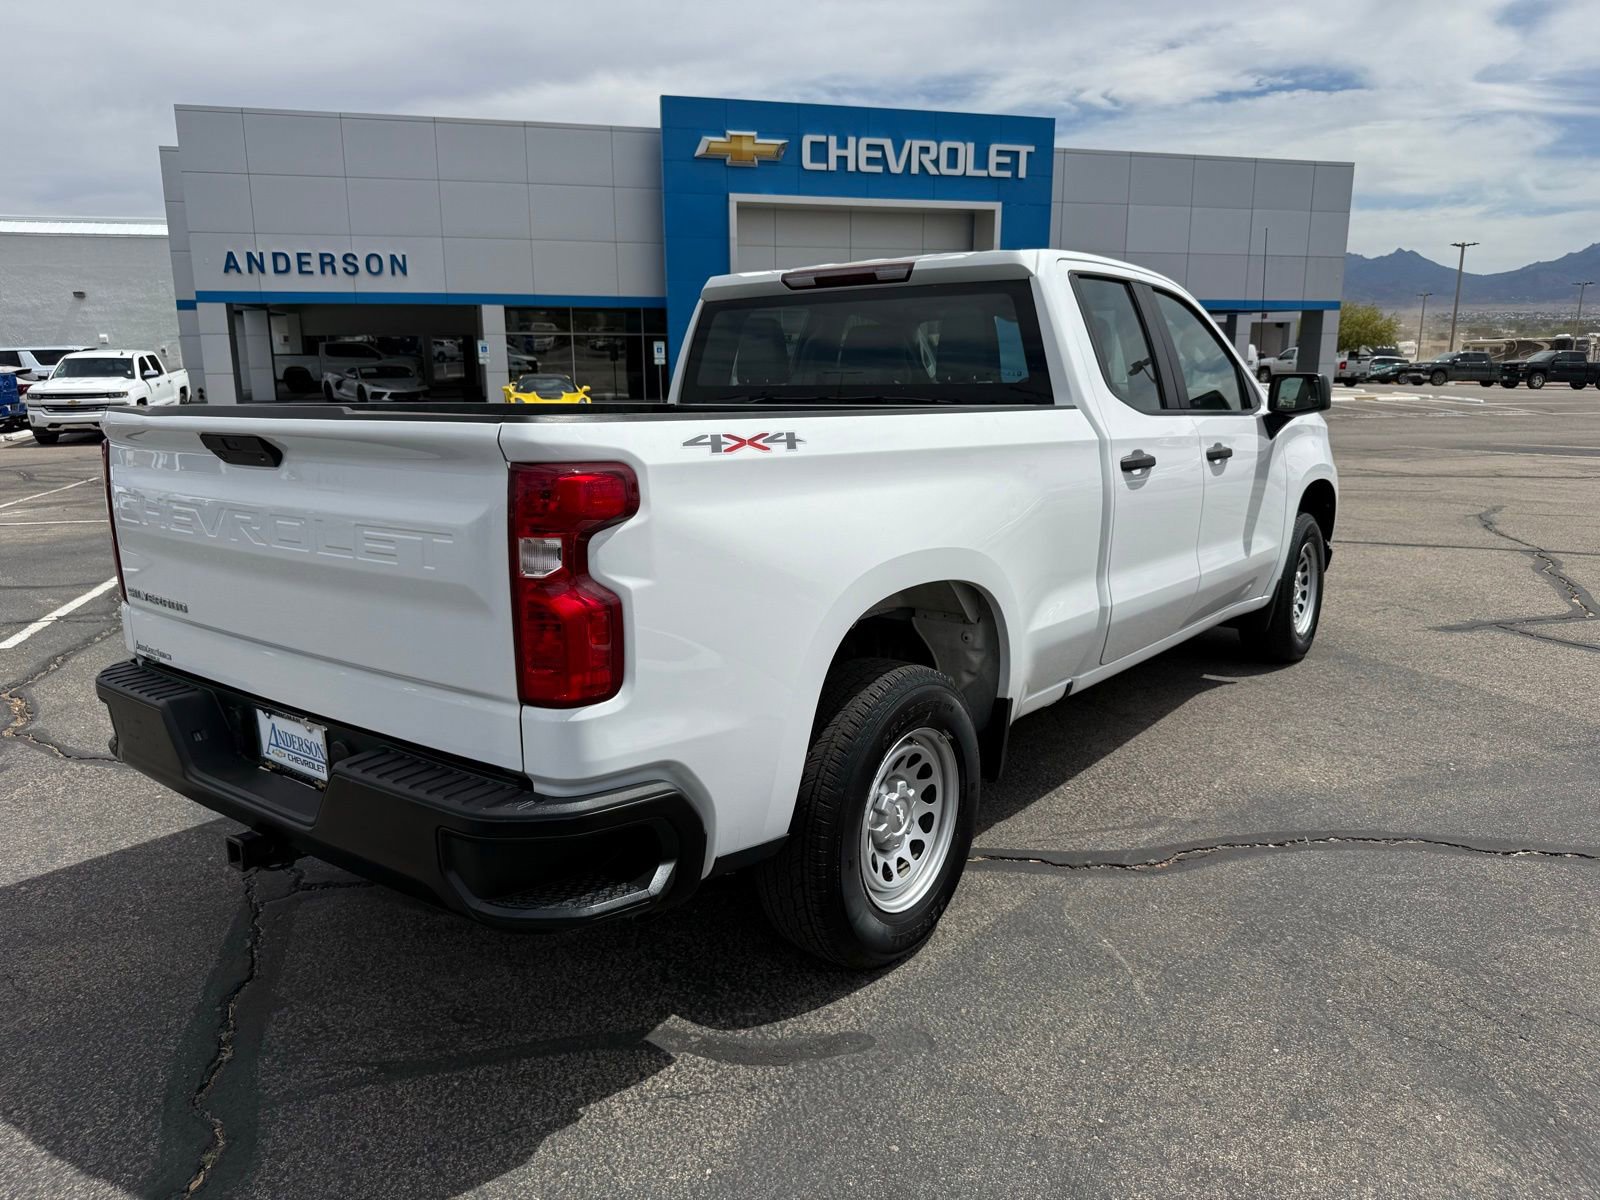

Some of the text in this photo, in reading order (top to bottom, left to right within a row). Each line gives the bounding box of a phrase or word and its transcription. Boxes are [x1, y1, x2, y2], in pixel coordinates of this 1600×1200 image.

[801, 134, 1035, 179] CHEVROLET
[223, 250, 408, 277] ANDERSON
[115, 492, 454, 570] CHEVROLET
[266, 722, 326, 761] ANDERSON
[288, 754, 325, 774] CHEVROLET
